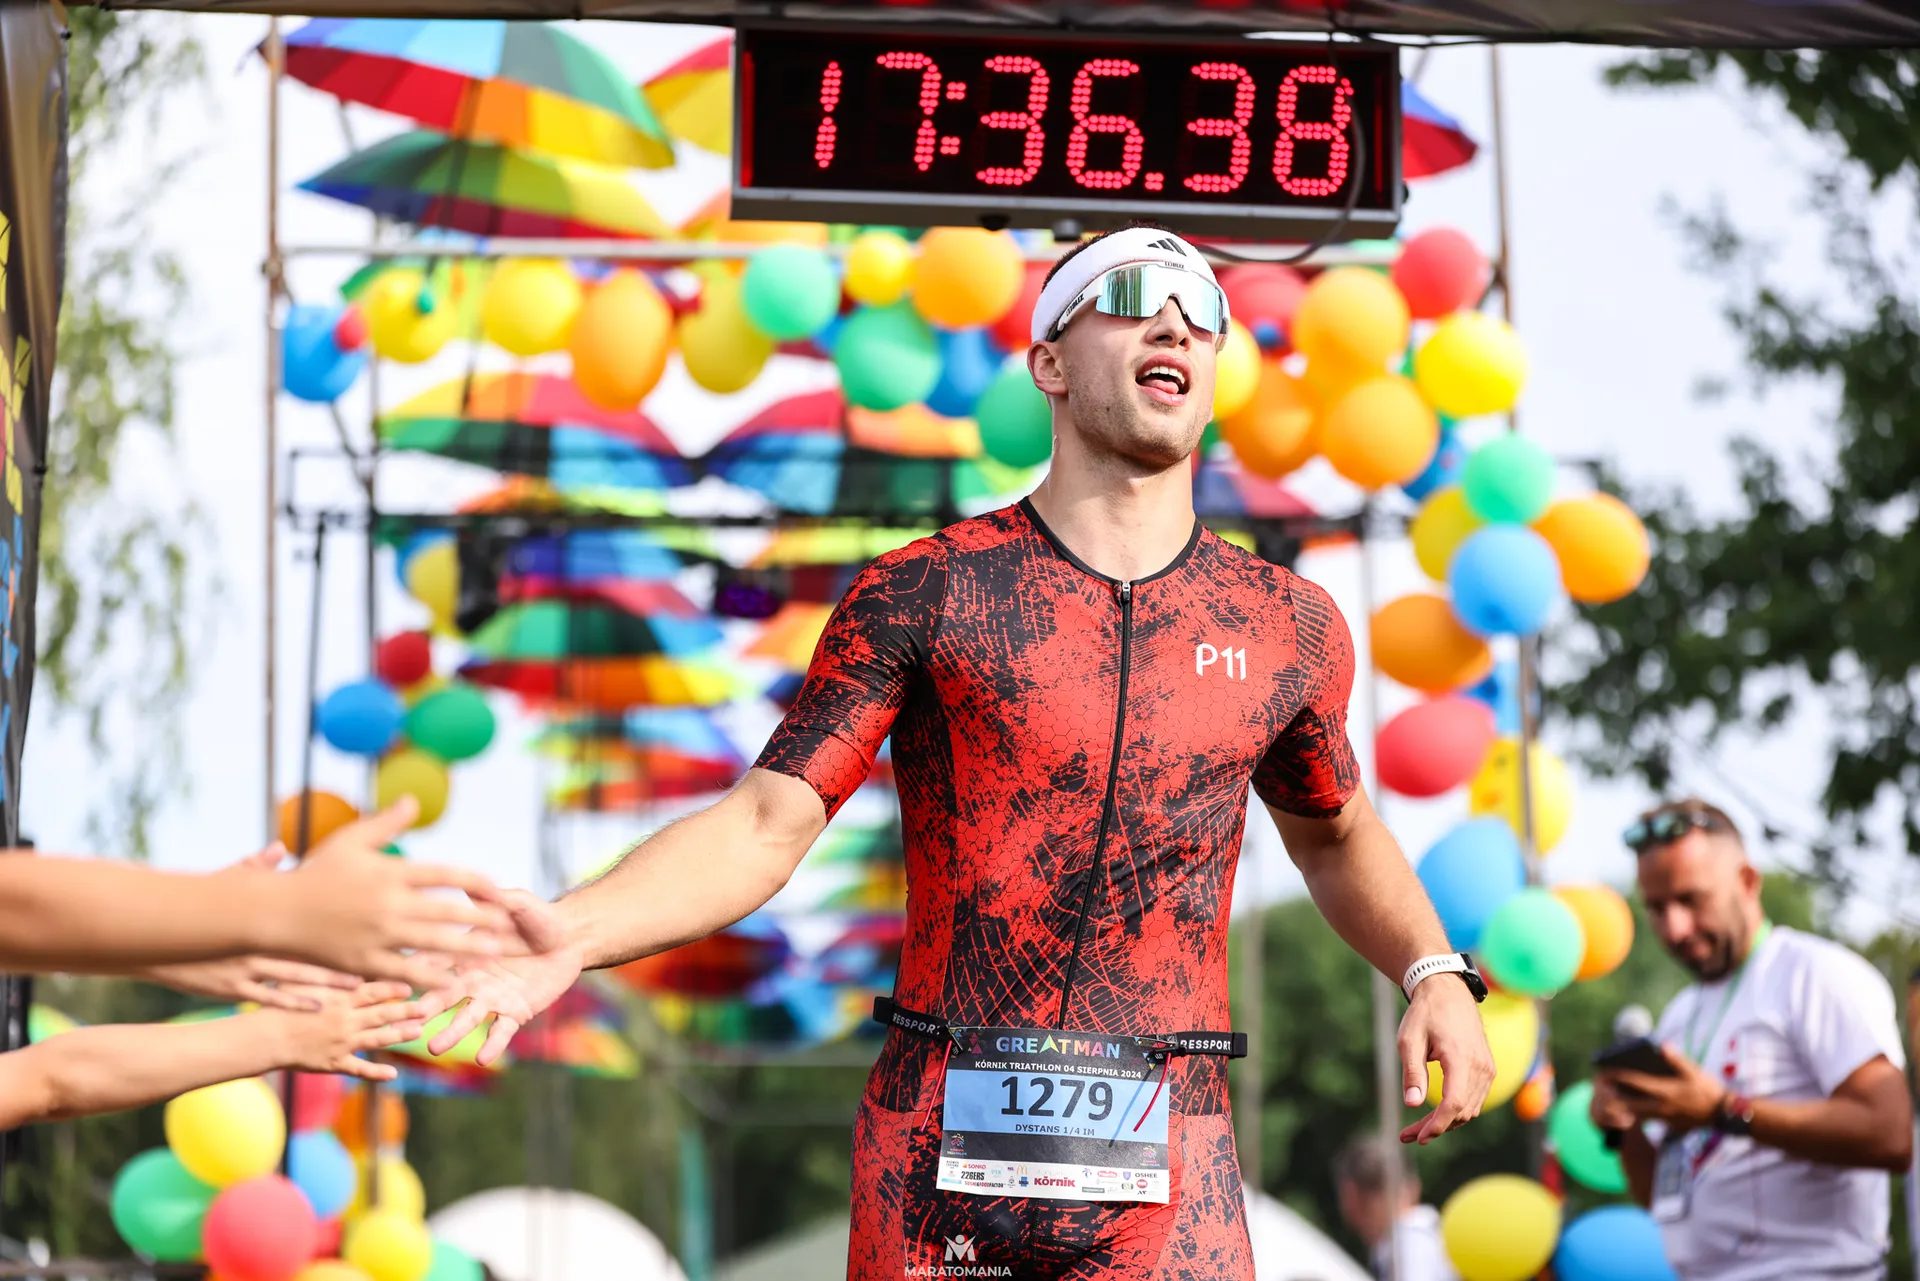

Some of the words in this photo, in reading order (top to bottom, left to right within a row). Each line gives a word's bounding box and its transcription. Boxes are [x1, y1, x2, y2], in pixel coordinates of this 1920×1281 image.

[814, 51, 1353, 197] 17:36.38
[1195, 642, 1247, 681] P11
[996, 1033, 1120, 1059] GREATMAN
[975, 1059, 1008, 1070] KÓRNIK
[1009, 1062, 1061, 1072] TRIATHLON
[1063, 1064, 1075, 1073] 04
[1077, 1066, 1119, 1077] SIERPNIA
[1120, 1069, 1142, 1079] 2024
[1001, 1075, 1113, 1121] 1279
[1015, 1123, 1060, 1134] DYSTANS
[1063, 1126, 1080, 1136] 1/4
[1083, 1127, 1095, 1136] IM
[960, 1170, 985, 1181] 226ERS
